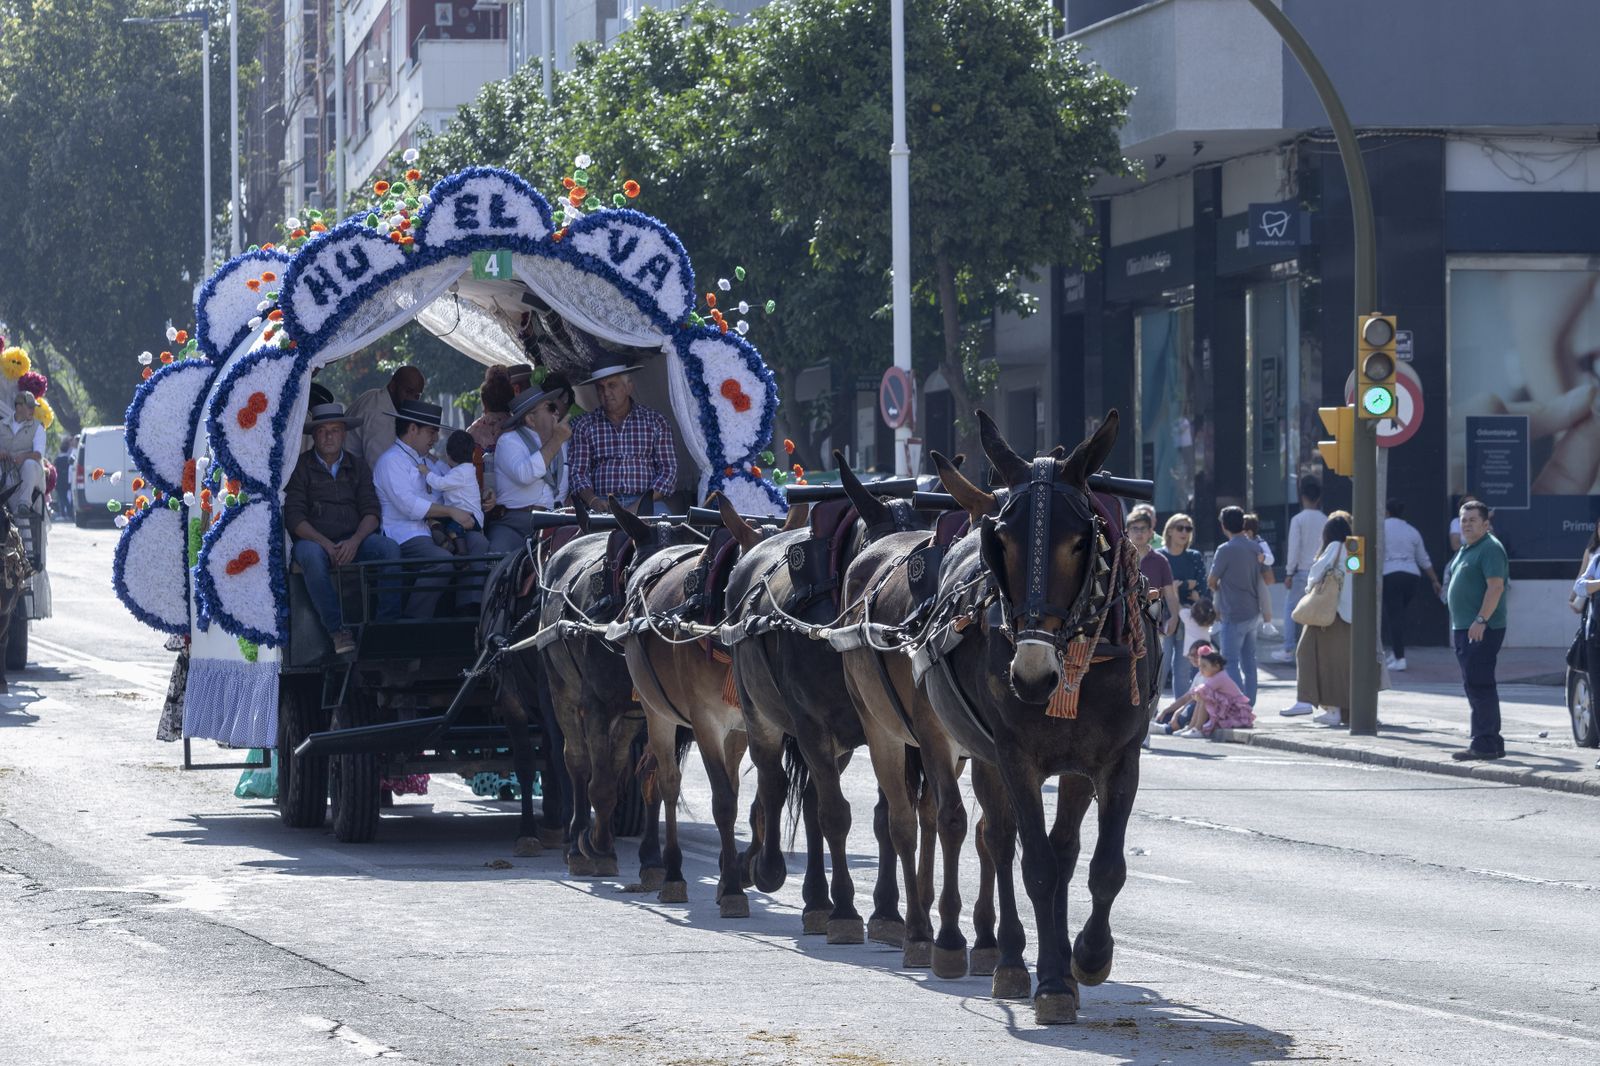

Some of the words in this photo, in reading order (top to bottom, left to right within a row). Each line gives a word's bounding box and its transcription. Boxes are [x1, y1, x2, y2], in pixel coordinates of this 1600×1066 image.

[303, 243, 371, 306] HU
[454, 194, 518, 230] EL
[608, 228, 675, 291] VA
[484, 254, 500, 278] 4
